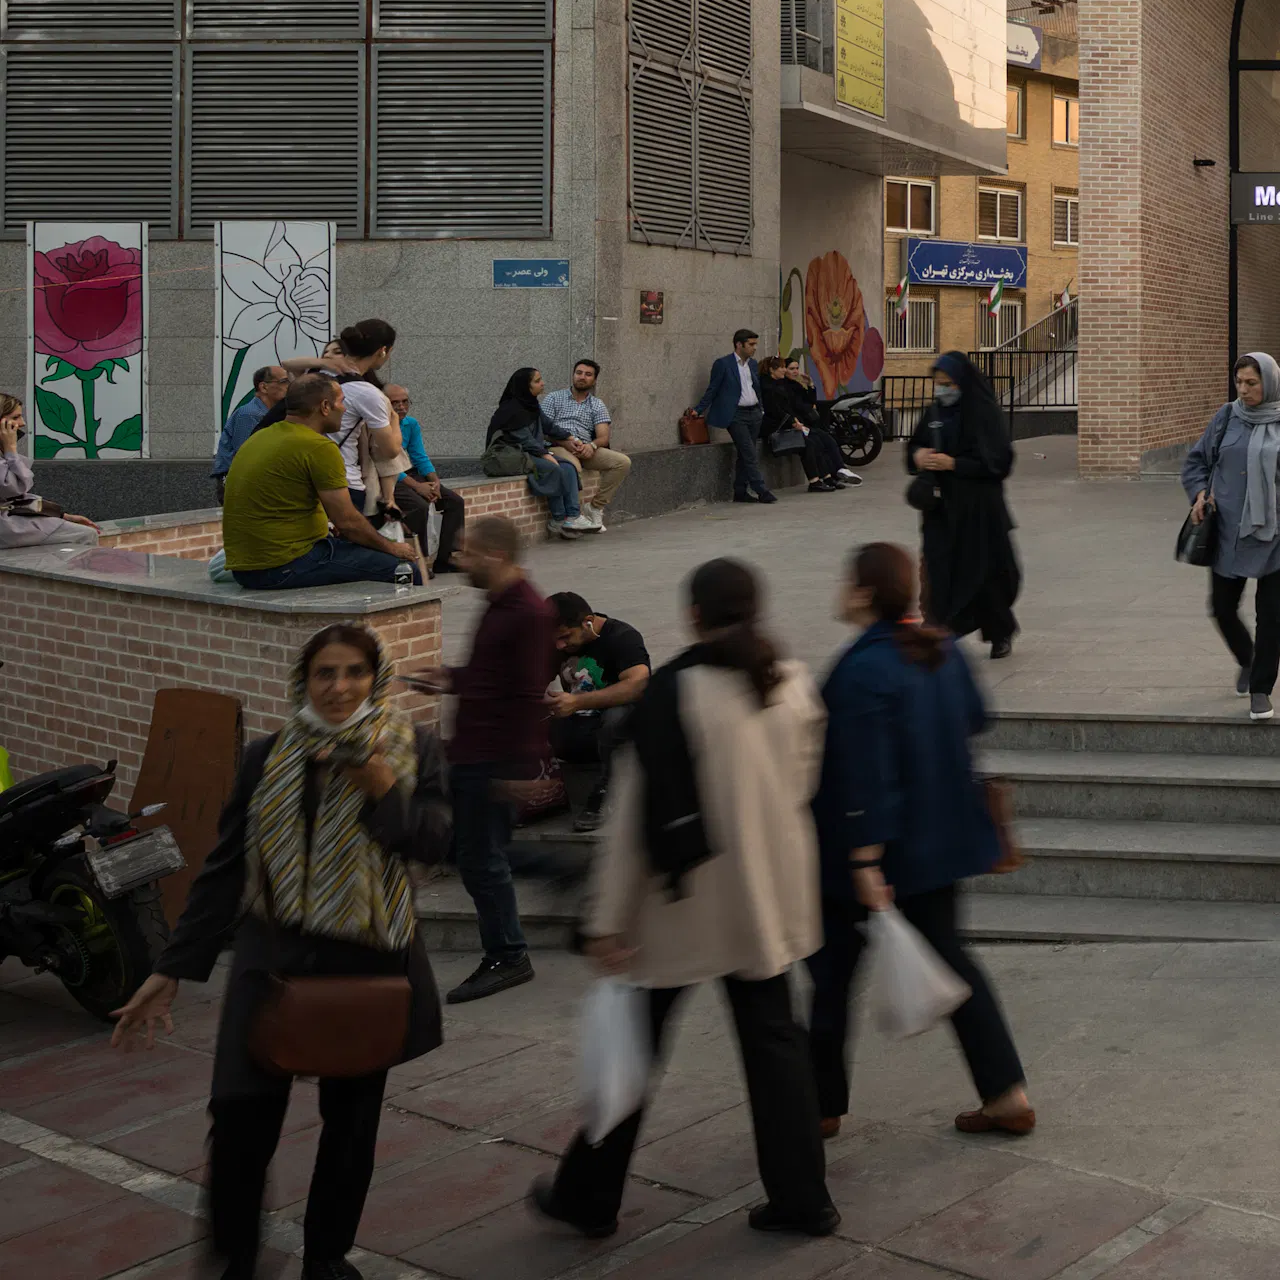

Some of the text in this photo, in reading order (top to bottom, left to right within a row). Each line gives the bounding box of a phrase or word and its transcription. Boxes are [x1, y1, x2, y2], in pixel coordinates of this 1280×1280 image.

[1248, 212, 1274, 221] Line
[512, 269, 532, 278] عصر
[533, 267, 549, 278] ولی
[921, 264, 1014, 282] بخشداری مرکزی تهران
